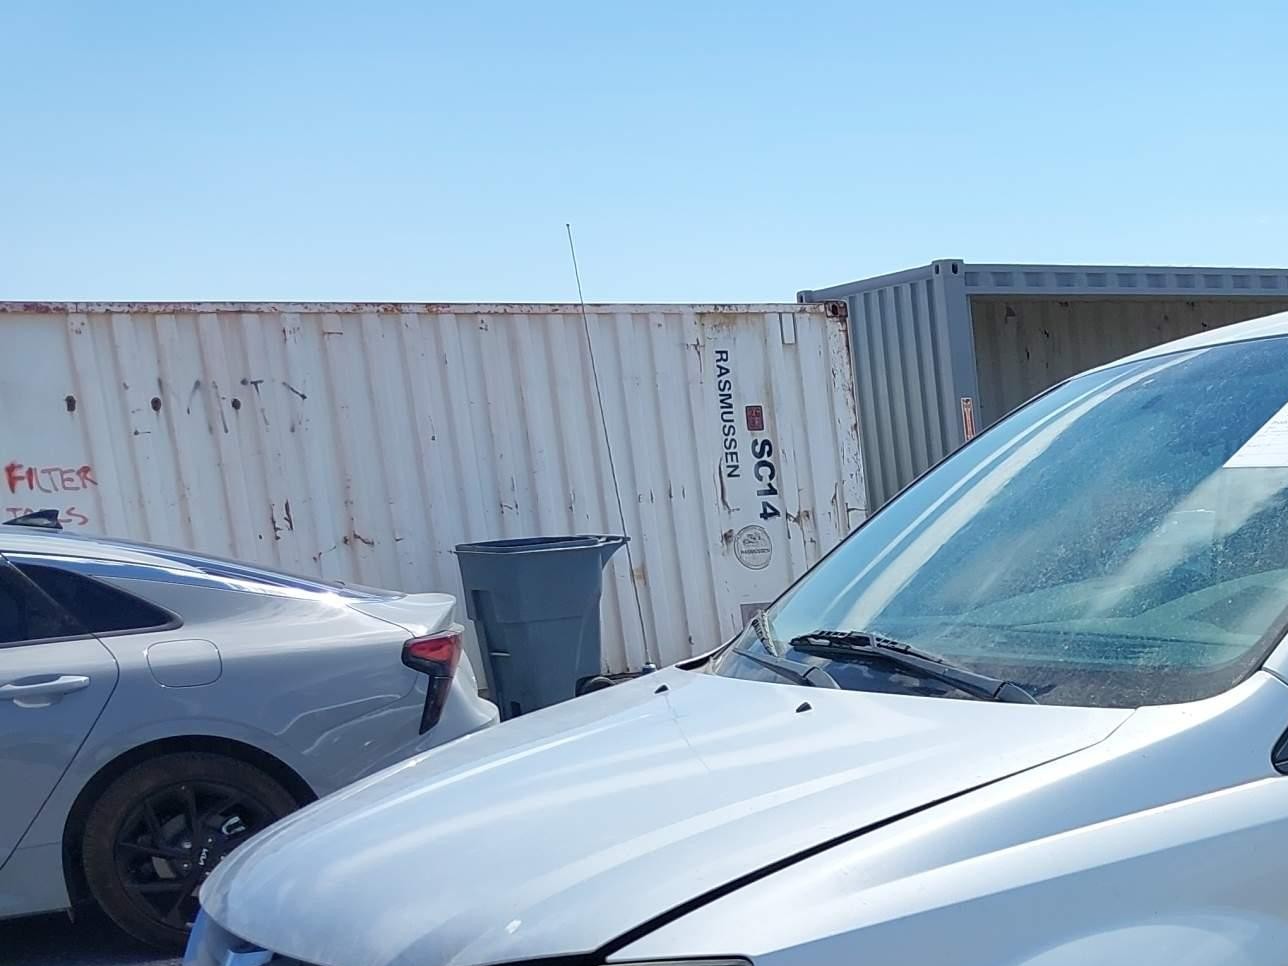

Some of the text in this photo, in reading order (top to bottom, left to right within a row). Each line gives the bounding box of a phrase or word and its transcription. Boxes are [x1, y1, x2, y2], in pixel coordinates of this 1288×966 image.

[714, 350, 740, 478] RASMUSSEN
[4, 462, 98, 494] FILTER
[751, 438, 781, 521] SC14
